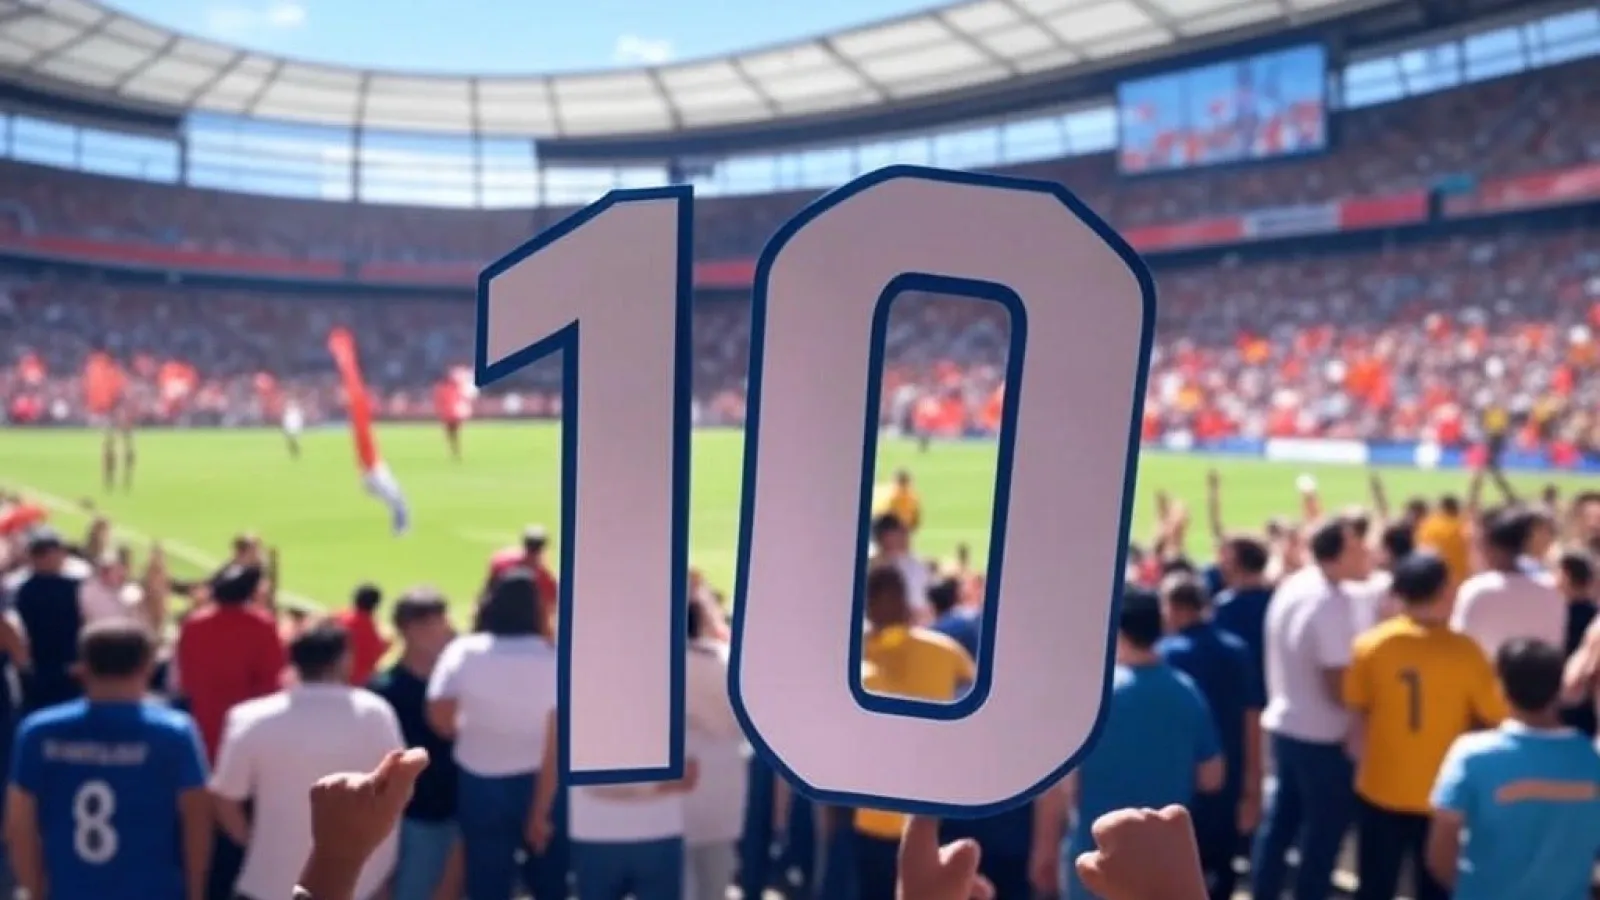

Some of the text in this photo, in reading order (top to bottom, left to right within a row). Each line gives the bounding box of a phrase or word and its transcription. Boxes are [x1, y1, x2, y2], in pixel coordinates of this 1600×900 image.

[475, 164, 1157, 818] 10
[1397, 667, 1422, 733] 1
[73, 780, 119, 863] 8
